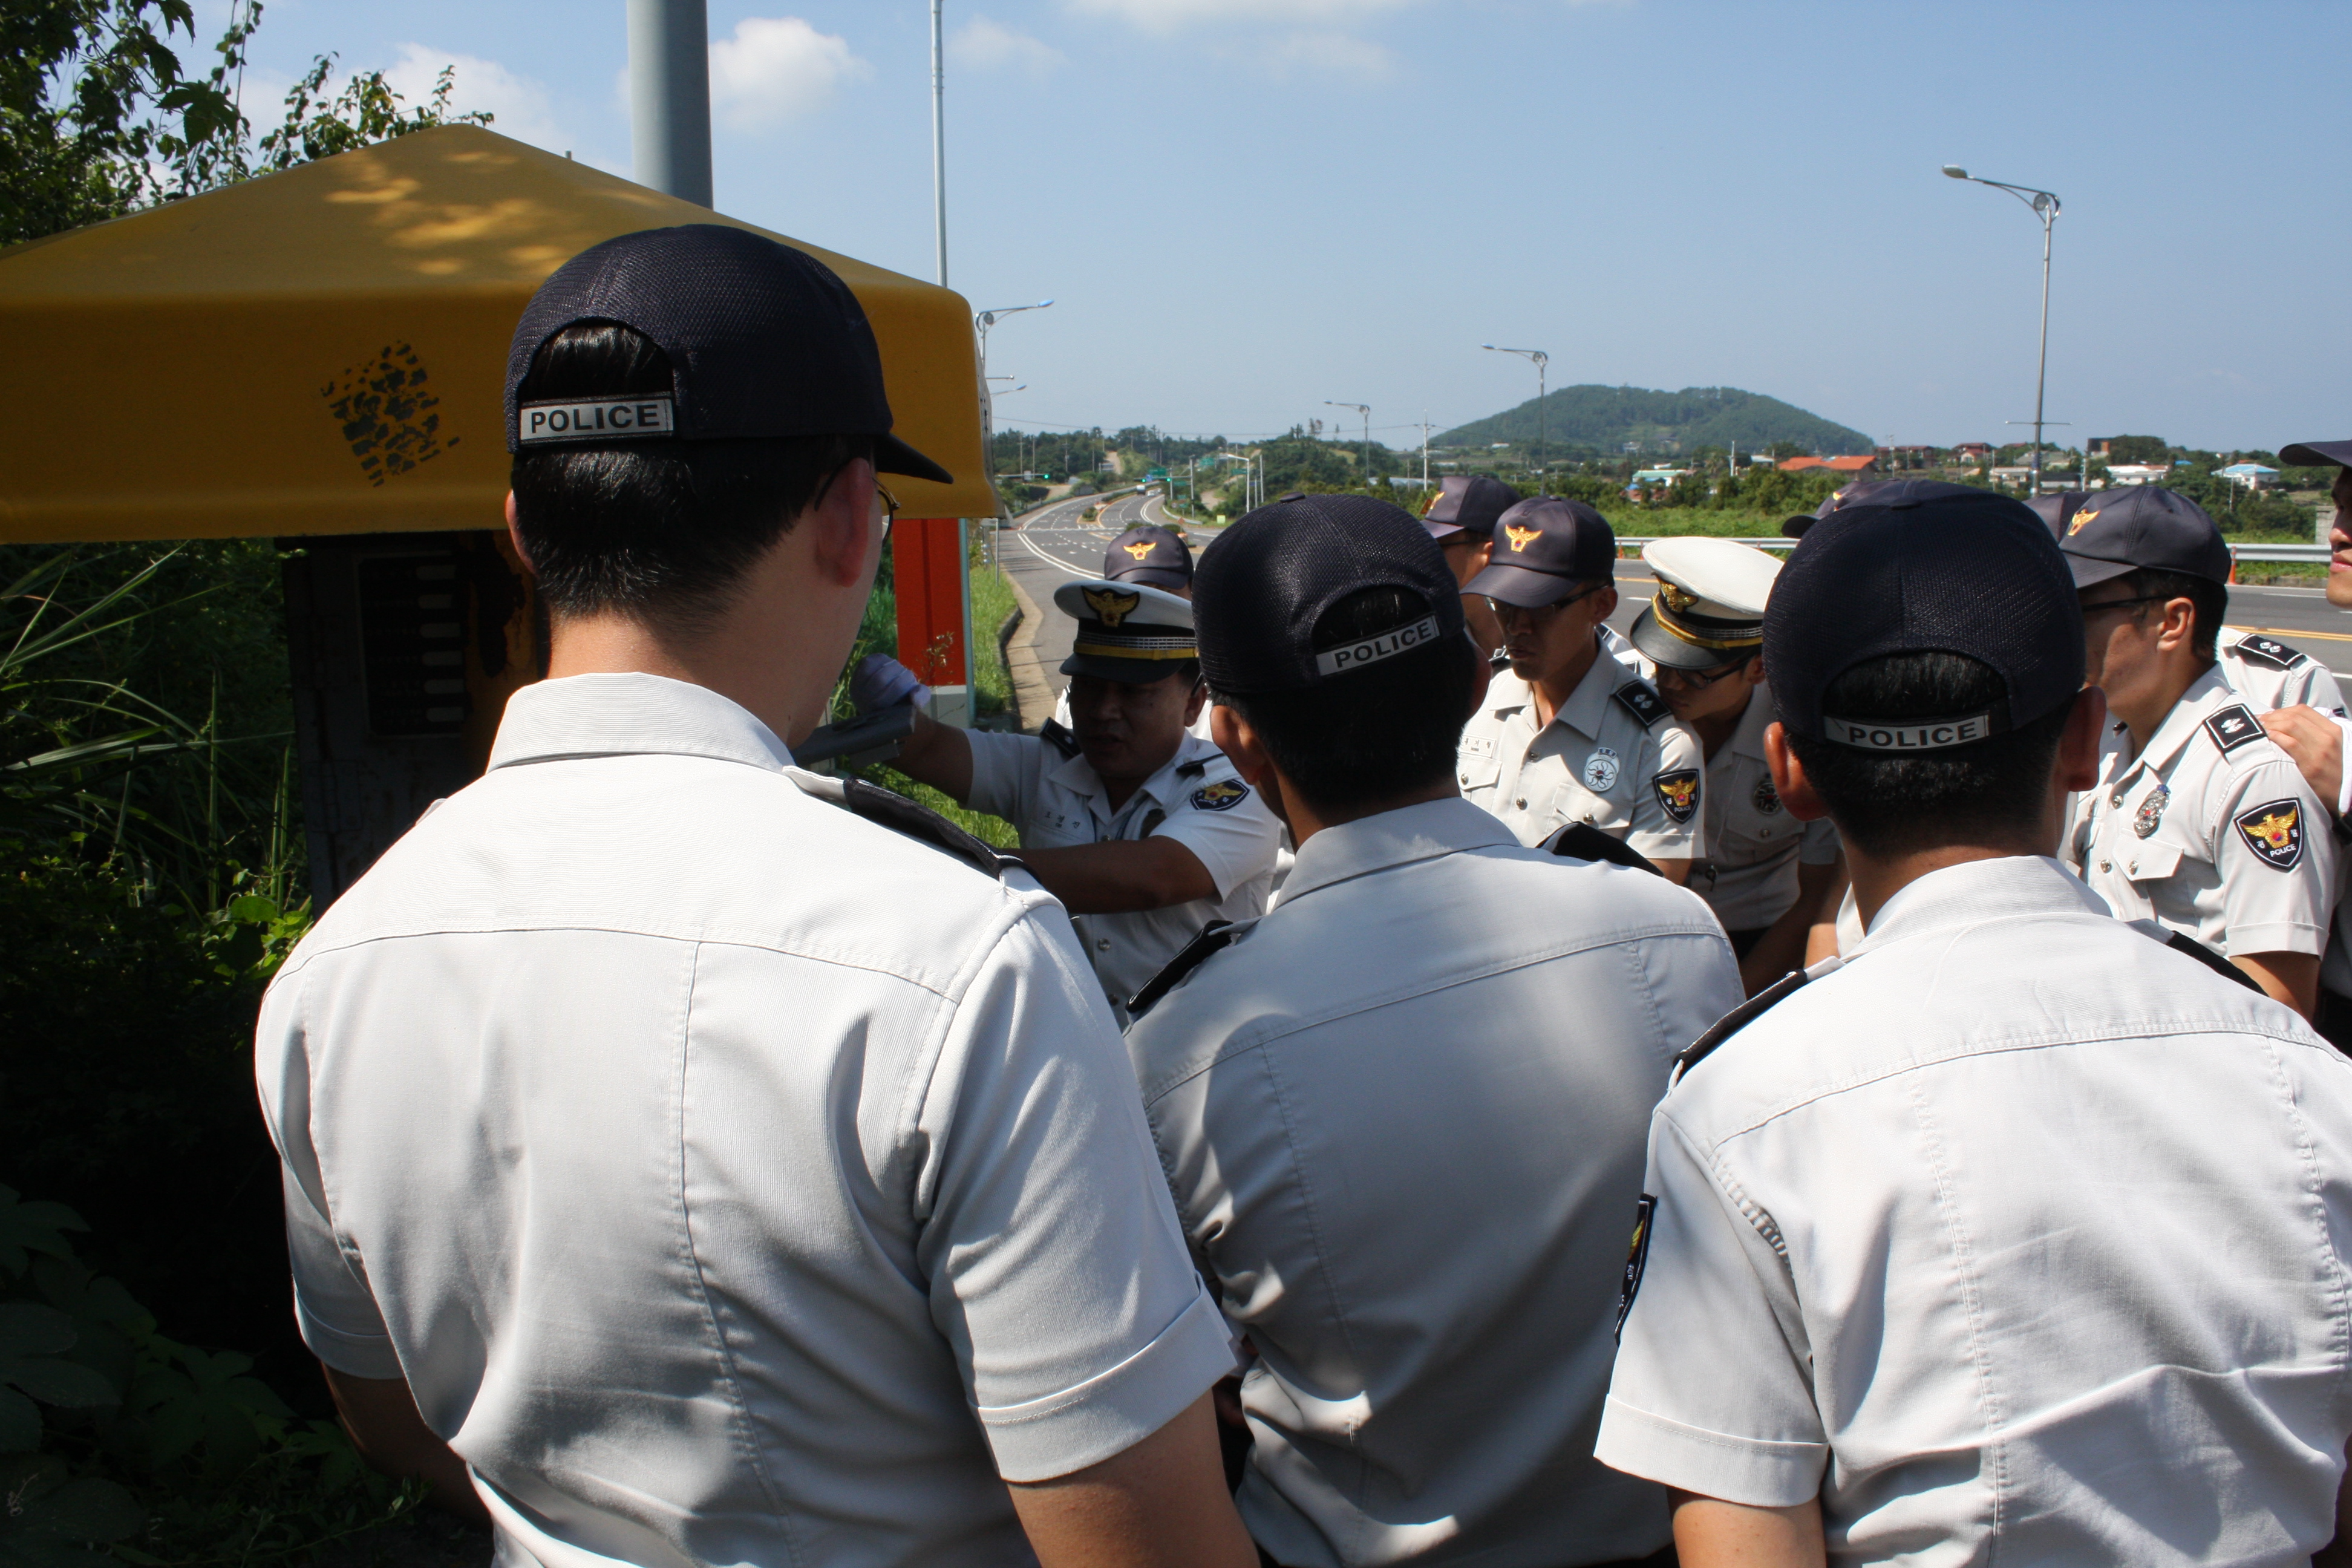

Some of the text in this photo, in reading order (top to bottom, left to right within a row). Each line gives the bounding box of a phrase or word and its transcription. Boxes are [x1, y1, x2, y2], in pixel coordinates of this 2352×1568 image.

[531, 404, 660, 434] POLICE
[1334, 622, 1432, 668] POLICE
[1849, 722, 1977, 747] POLICE
[2270, 844, 2296, 857] POLICE
